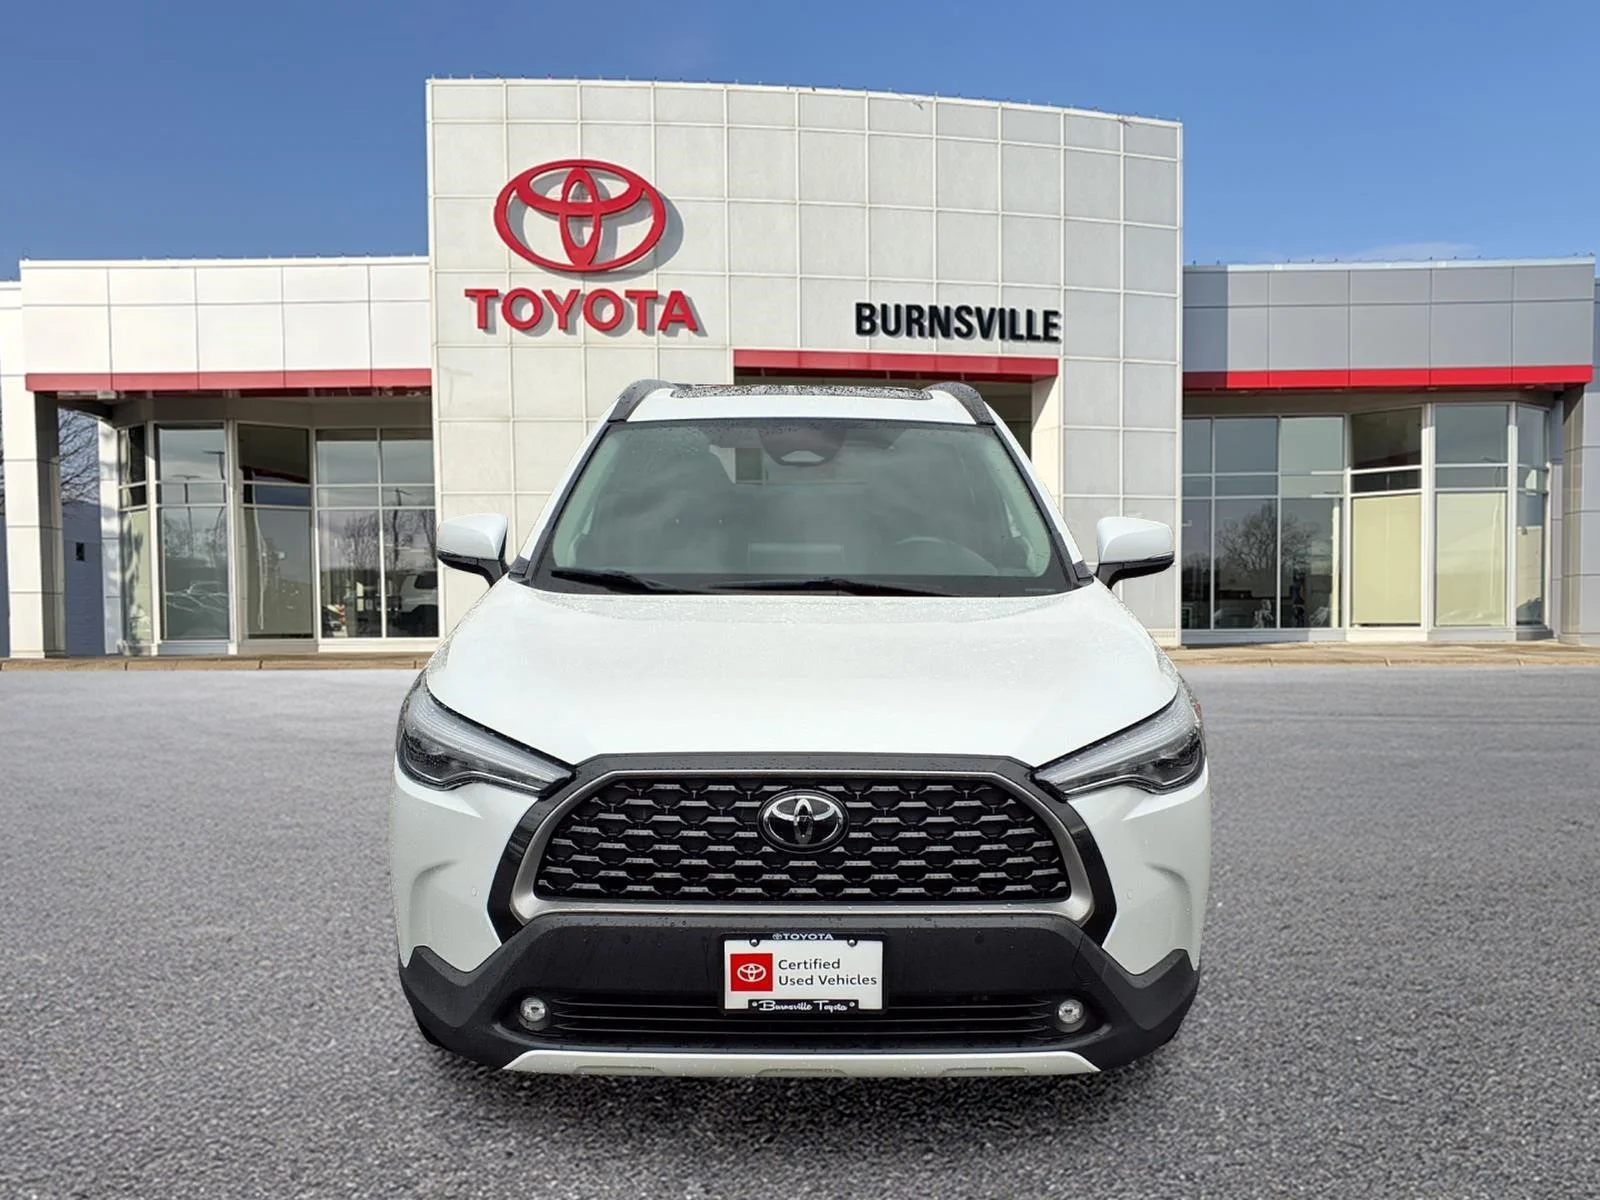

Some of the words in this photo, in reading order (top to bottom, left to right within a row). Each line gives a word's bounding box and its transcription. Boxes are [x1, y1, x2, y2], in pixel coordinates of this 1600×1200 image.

[465, 288, 699, 332] TOYOTA
[855, 302, 1062, 343] BURNSVILLE
[778, 958, 840, 970] Certified
[778, 975, 814, 986] Used
[818, 974, 877, 986] Vehicles
[758, 1000, 812, 1011] Burnsville
[814, 1000, 847, 1012] Toyota
